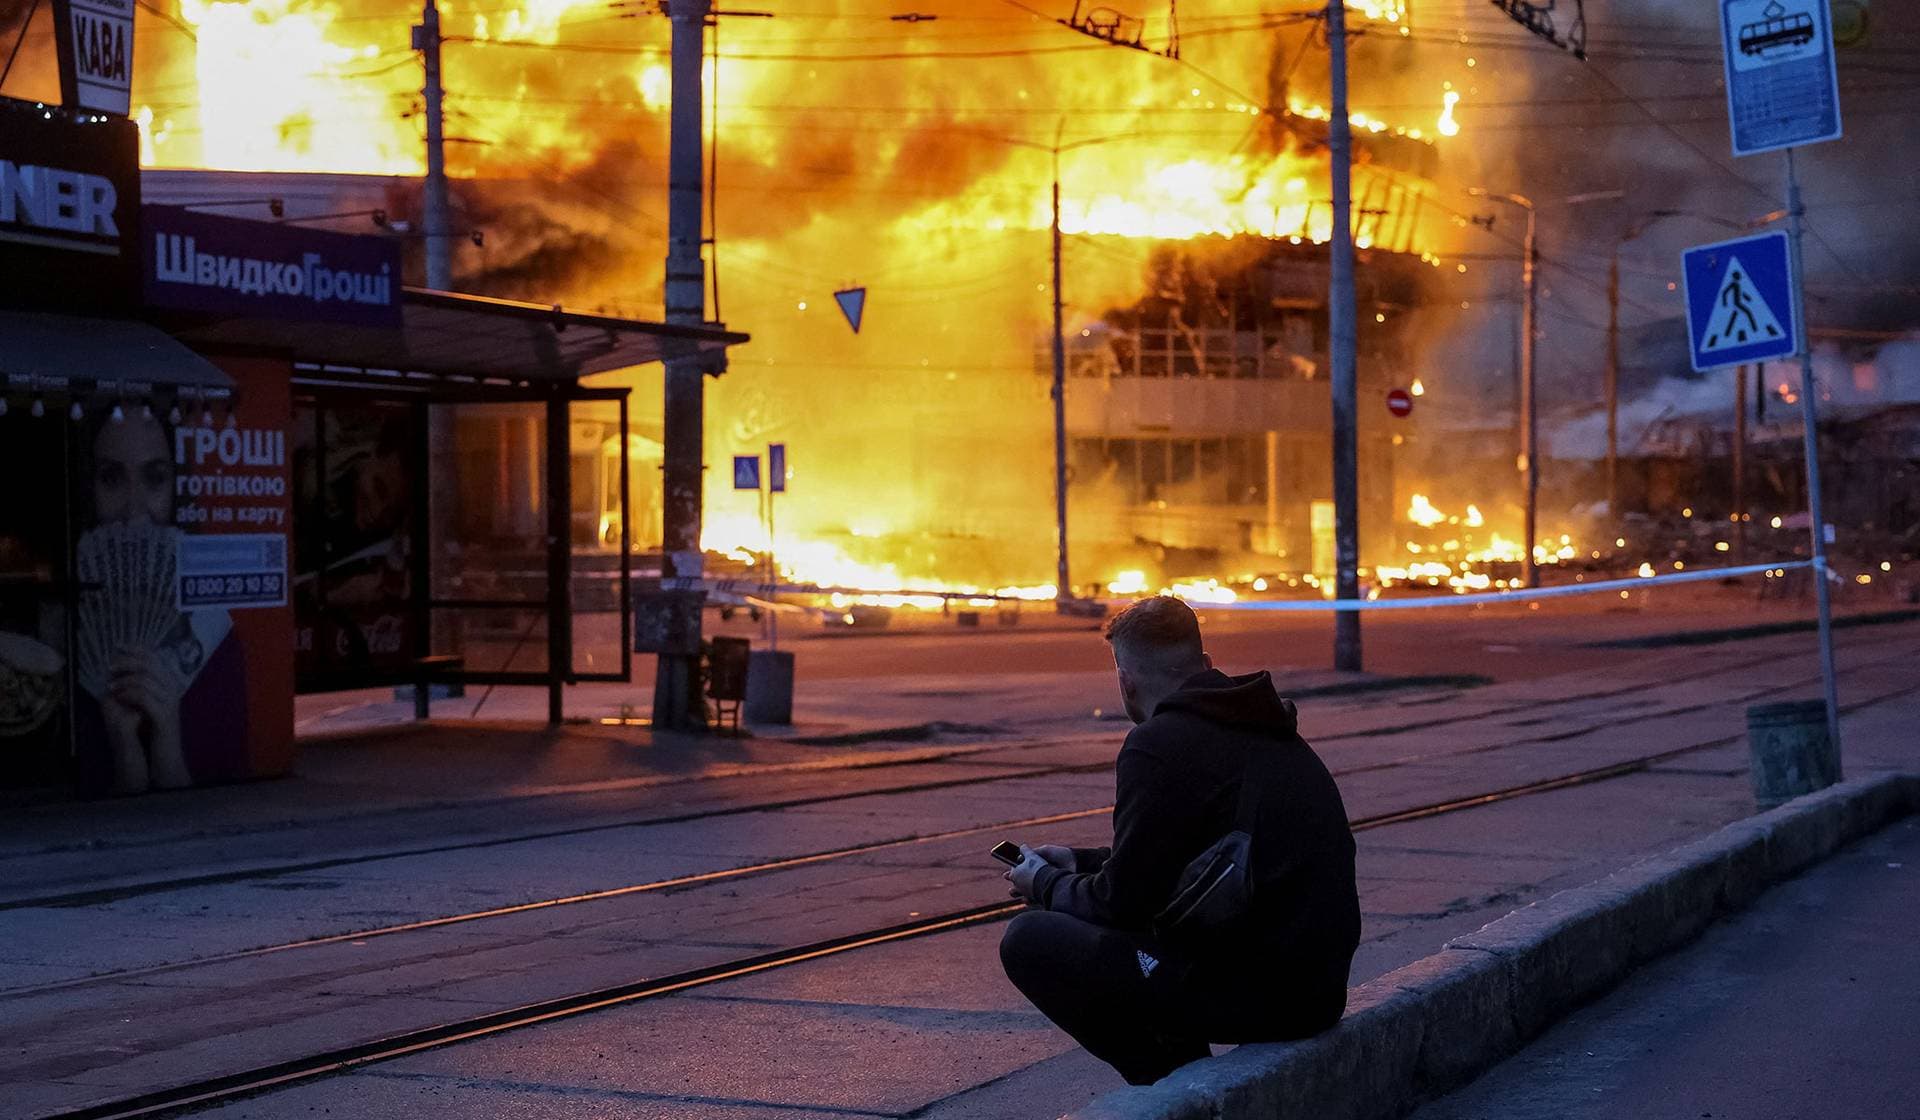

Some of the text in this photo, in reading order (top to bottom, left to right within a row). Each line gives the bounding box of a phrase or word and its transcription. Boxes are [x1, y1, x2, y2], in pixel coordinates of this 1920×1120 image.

[75, 14, 126, 81] КАВА
[155, 232, 391, 305] ШвидкоГроші
[174, 425, 286, 466] ГРОШІ
[176, 502, 286, 526] або на карту
